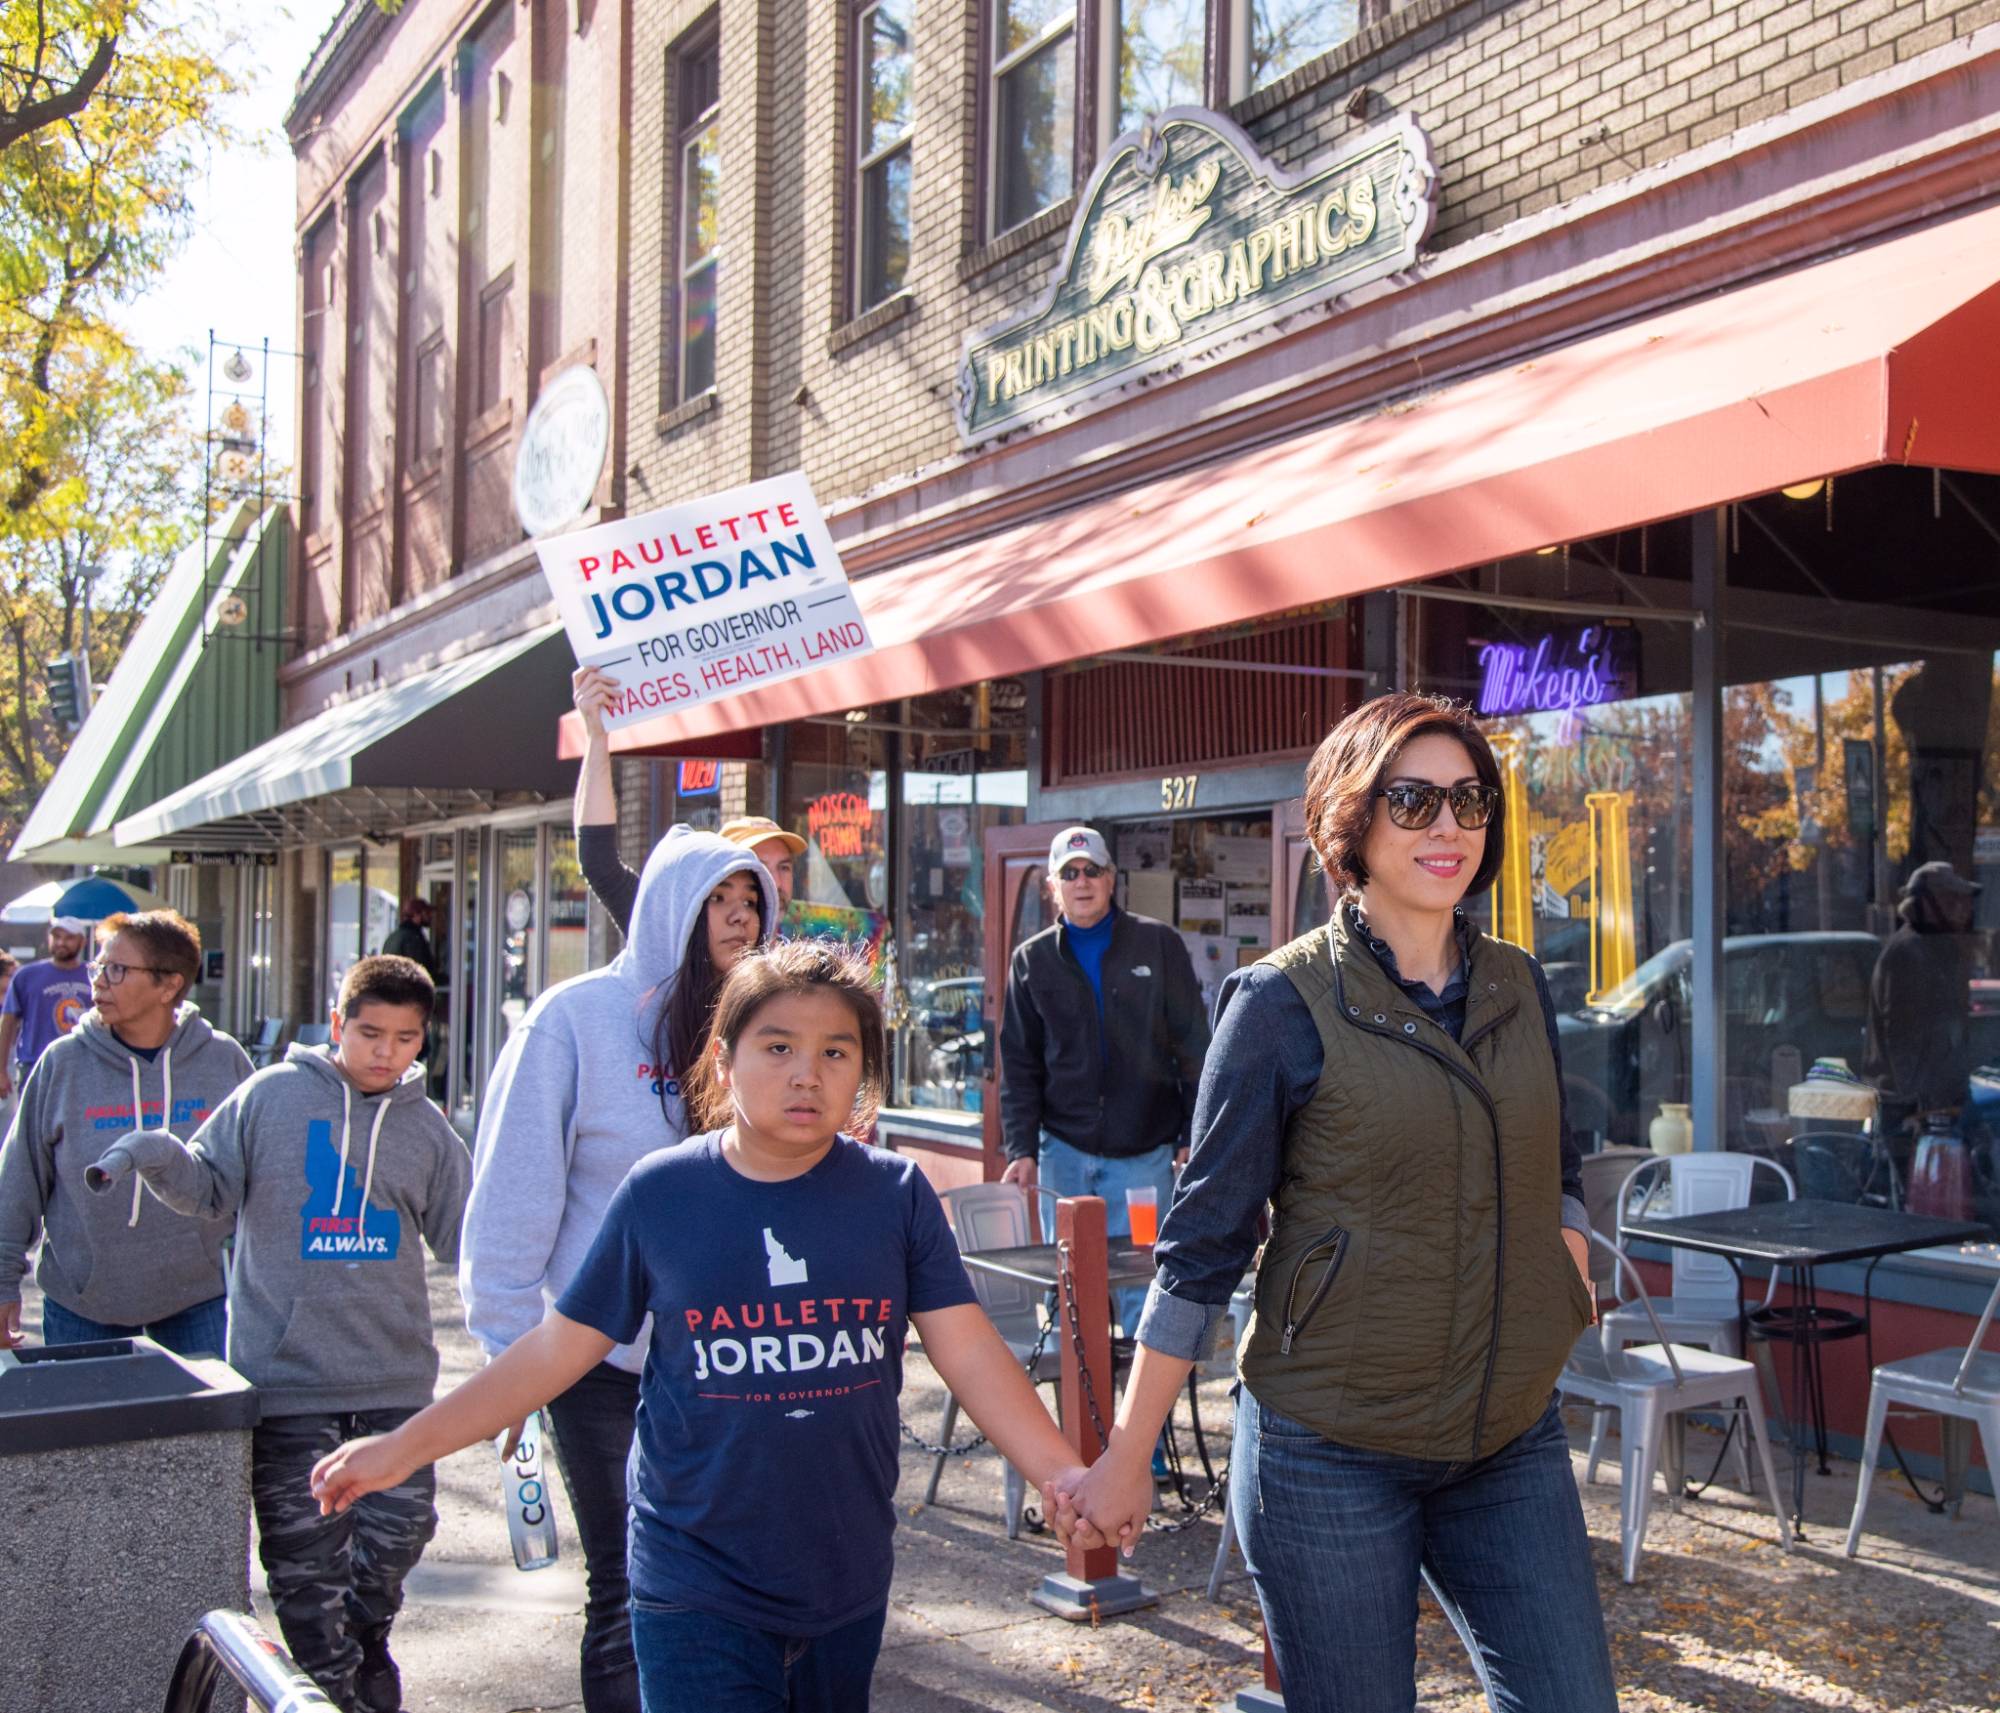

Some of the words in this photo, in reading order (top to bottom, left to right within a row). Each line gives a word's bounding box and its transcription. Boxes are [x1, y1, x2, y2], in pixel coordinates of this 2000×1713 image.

[987, 297, 1134, 407] PRINTING
[1133, 267, 1182, 353] &
[1175, 174, 1378, 321] GRAPHICS
[579, 502, 800, 582] PAULETTE
[589, 533, 818, 640] JORDAN
[637, 633, 685, 668] FOR
[686, 599, 803, 653] GOVERNOR
[602, 672, 700, 719] WAGES,
[699, 642, 801, 691] HEALTH,
[800, 621, 865, 662] LAND
[1161, 775, 1198, 810] 527
[808, 791, 872, 834] MOSCOW
[820, 825, 862, 858] PAWN
[637, 1063, 677, 1079] PAU
[651, 1081, 680, 1096] GO
[84, 1101, 169, 1120] PAULTT
[95, 1110, 191, 1130] GOVRNR
[307, 1236, 389, 1253] ALWAYS.
[684, 1298, 892, 1332] PAULETTE
[693, 1325, 886, 1380] JORDAN
[746, 1393, 772, 1402] FOR
[779, 1386, 850, 1401] GOVERNOR
[514, 1441, 546, 1526] core
